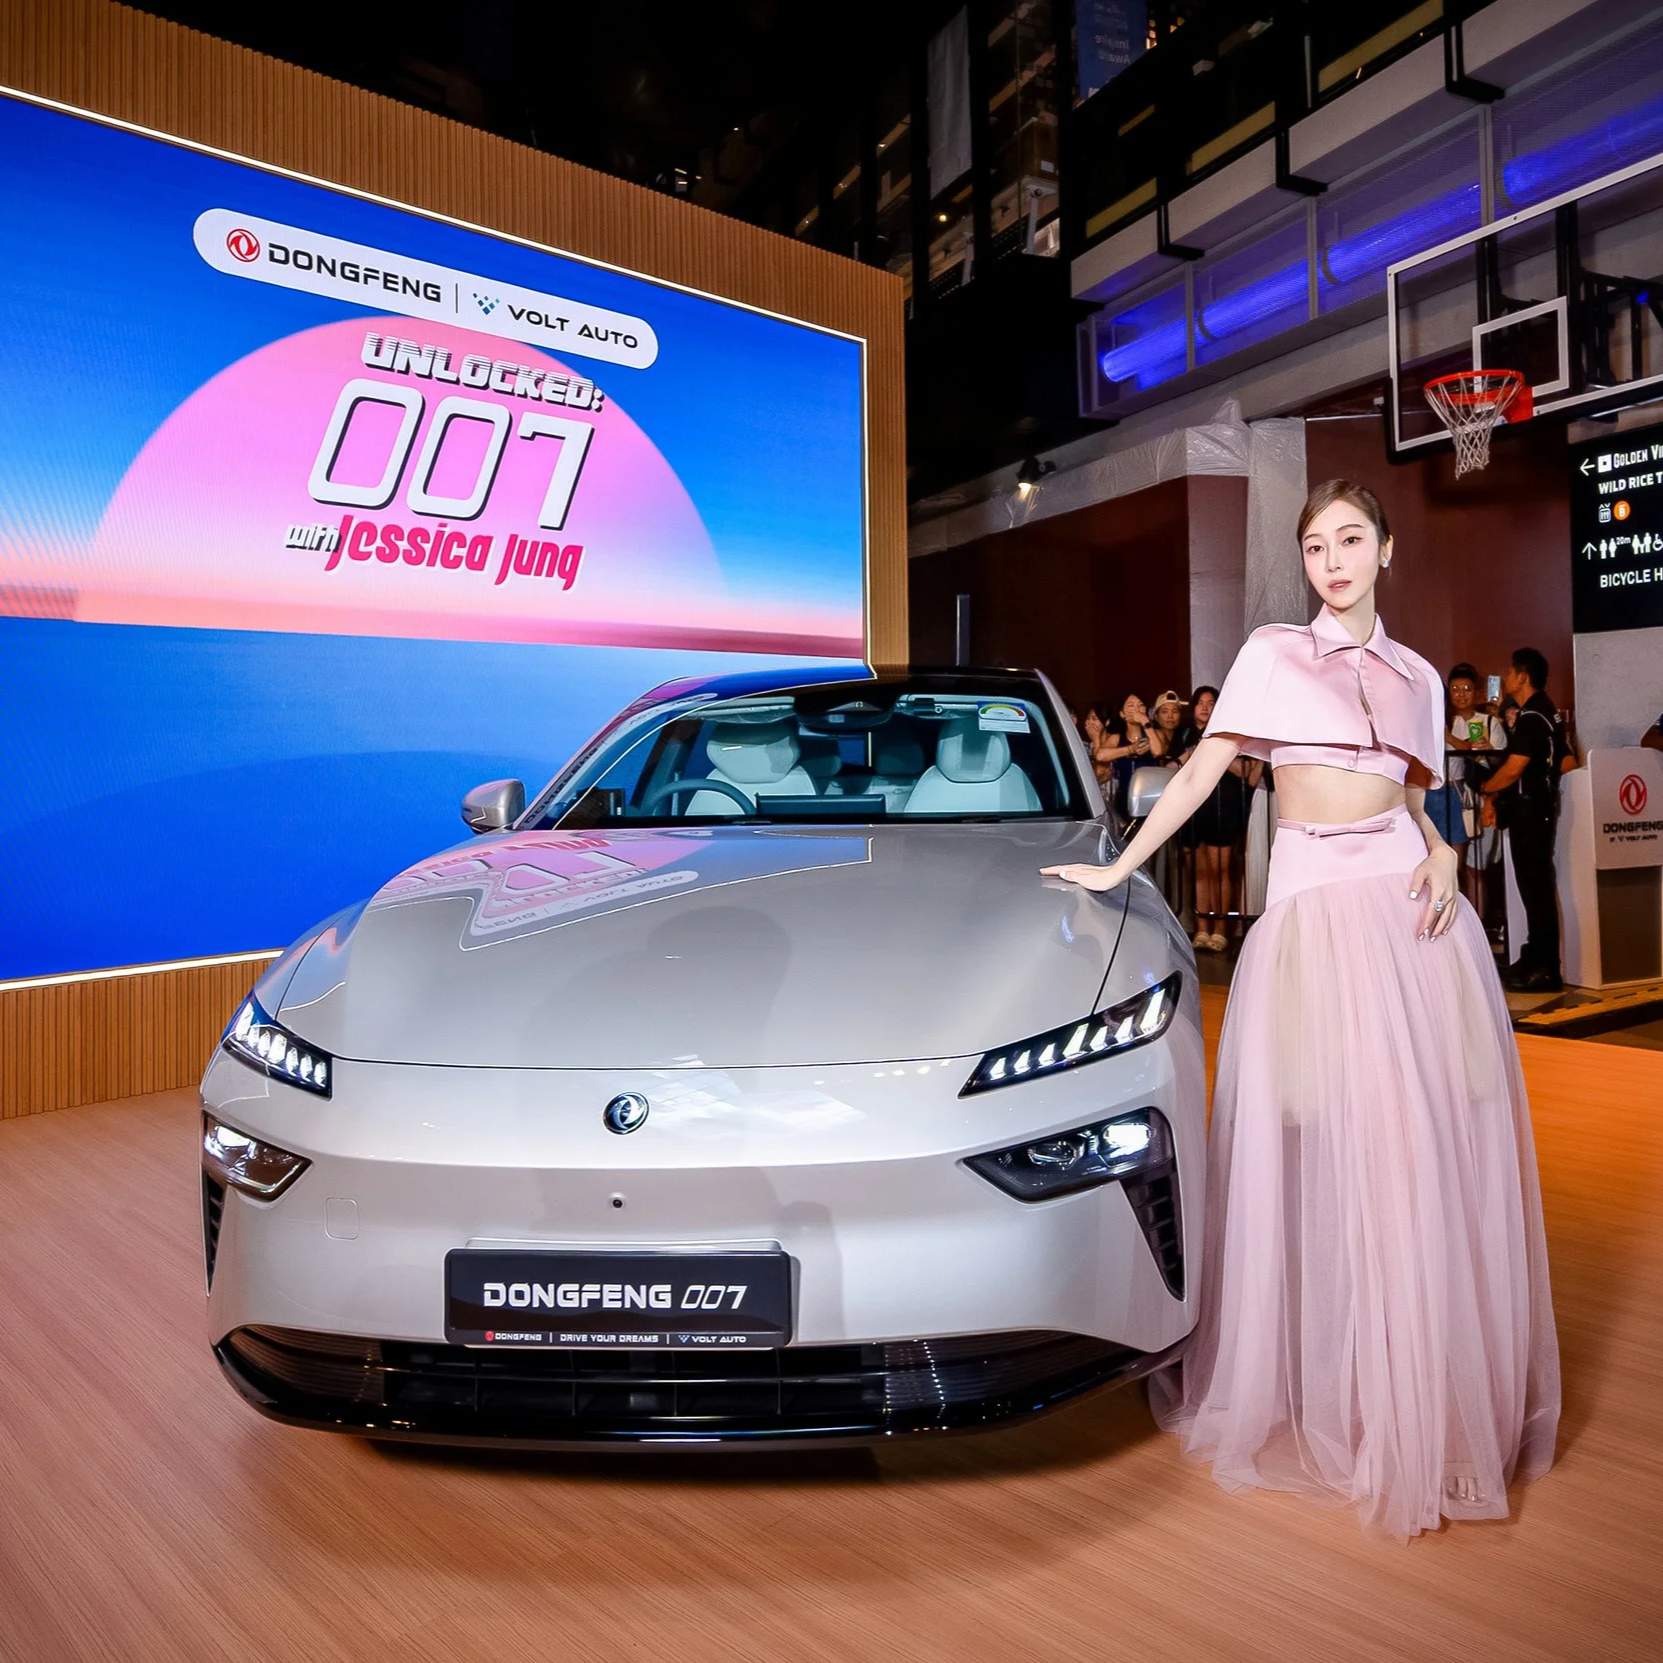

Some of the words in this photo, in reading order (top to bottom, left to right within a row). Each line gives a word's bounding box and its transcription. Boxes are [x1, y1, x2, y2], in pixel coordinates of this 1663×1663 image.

[268, 242, 441, 303] DONGFENG
[506, 304, 570, 332] VOLT
[577, 323, 639, 349] AUTO
[360, 331, 605, 412] UNLOCKED:
[307, 378, 595, 531] 007
[1613, 449, 1648, 469] GOLDEN
[1598, 478, 1627, 495] WILD
[1628, 472, 1654, 489] RICE
[323, 513, 495, 573] Jessica
[493, 532, 585, 593] Jung
[1616, 536, 1631, 545] 20m
[1600, 568, 1652, 588] BICYCLE
[1603, 821, 1663, 834] DONGFENG
[483, 1282, 672, 1309] DONGFENG
[680, 1285, 748, 1310] 007
[495, 1332, 542, 1341] DONGFENG
[560, 1333, 588, 1342] DRIVE
[591, 1334, 616, 1343] YOUR
[619, 1334, 659, 1343] DREAMS
[691, 1335, 717, 1343] VOLT
